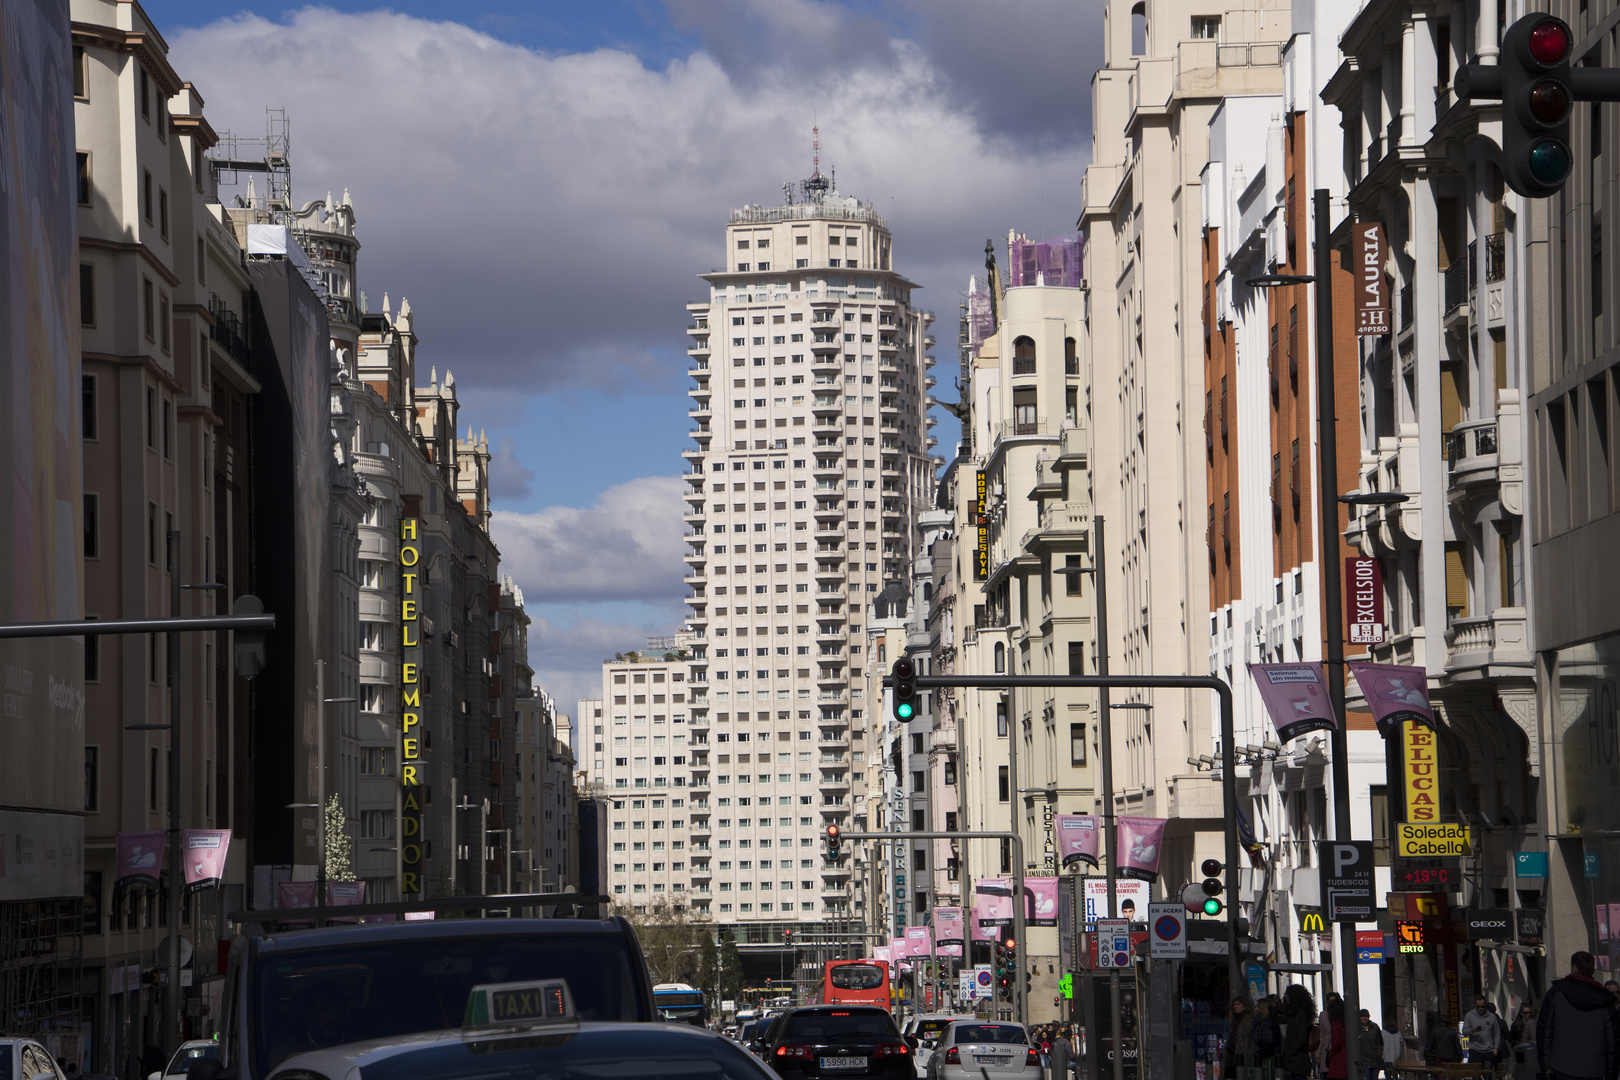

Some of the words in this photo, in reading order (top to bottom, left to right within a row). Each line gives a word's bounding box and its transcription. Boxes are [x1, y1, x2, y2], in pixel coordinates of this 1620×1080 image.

[1364, 226, 1380, 307] LAURIA
[977, 473, 986, 513] HOSTAL
[978, 527, 987, 576] BESAYA
[400, 519, 419, 646] HOTEL
[1356, 560, 1375, 623] EXCELSIOR
[49, 674, 75, 712] Reebok
[401, 662, 421, 893] EMPERADOR
[1043, 805, 1053, 854] HOSTAL
[1403, 826, 1465, 839] Soledad
[1406, 841, 1464, 854] Cabello
[1333, 844, 1360, 878] P
[895, 875, 907, 938] HOTEL
[1087, 898, 1097, 916] EL
[1470, 920, 1507, 928] GEOX
[495, 992, 541, 1017] TAXI
[826, 1058, 847, 1066] 5990
[849, 1058, 865, 1066] HCK
